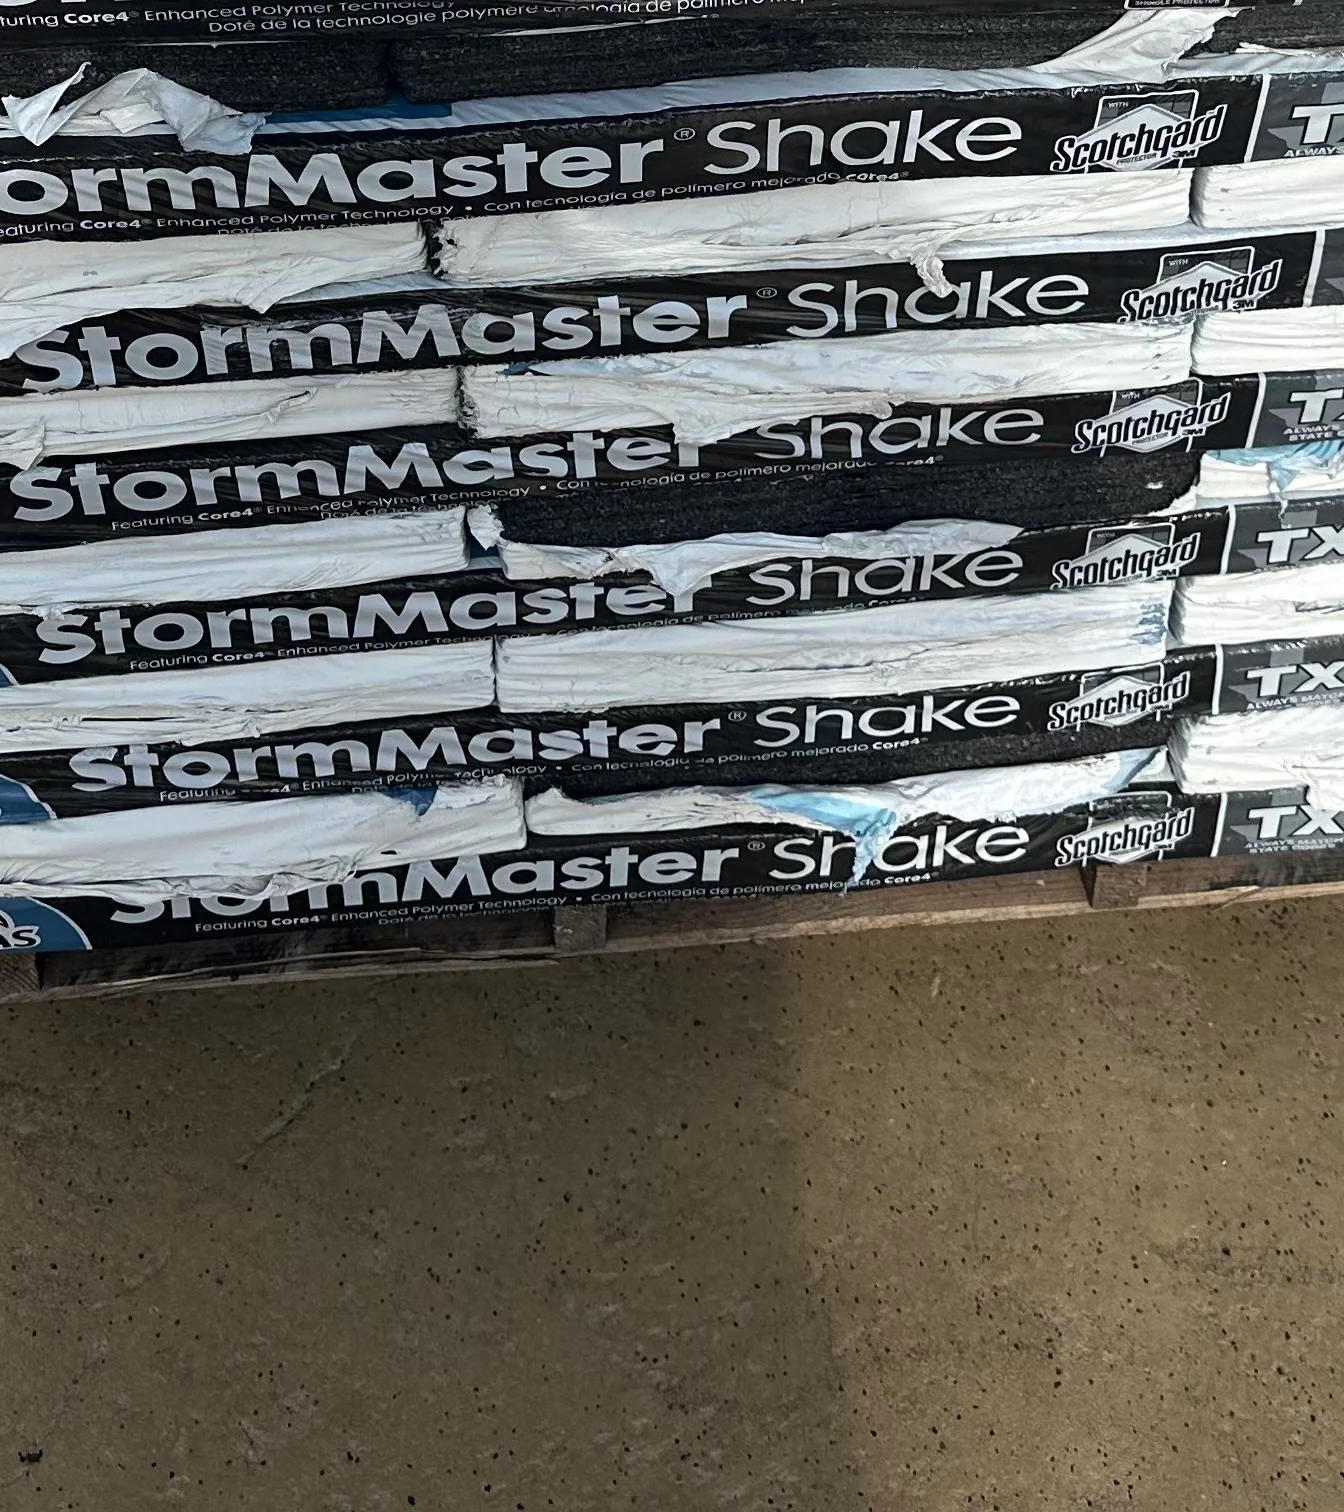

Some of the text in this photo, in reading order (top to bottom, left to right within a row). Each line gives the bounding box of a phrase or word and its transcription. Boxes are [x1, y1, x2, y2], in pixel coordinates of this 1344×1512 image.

[145, 6, 247, 23] Enhanced
[251, 3, 334, 18] Polymer
[645, 0, 673, 13] de
[208, 19, 257, 33] Doté
[260, 18, 289, 31] de
[292, 17, 312, 29] la
[315, 11, 437, 29] technologie
[705, 109, 1023, 174] Shake
[1051, 103, 1228, 173] Scotchgard
[156, 216, 254, 229] Enhanced
[260, 213, 338, 227] Polymer
[342, 206, 454, 221] Technology
[484, 202, 521, 213] Con
[525, 191, 628, 209] tecnología
[632, 189, 657, 199] de
[661, 181, 746, 198] polímero
[787, 272, 1089, 340] Shake
[1120, 259, 1282, 325] Scotchgard
[757, 406, 1044, 462] Shake
[1071, 392, 1230, 454] Scotchgard
[747, 546, 1023, 607] Shake
[1051, 533, 1199, 591] Scotchgard
[755, 693, 1019, 749] Shake
[1047, 670, 1191, 731] Scotchgard
[769, 824, 1029, 880] Shake
[1055, 806, 1195, 867] Scotchgard
